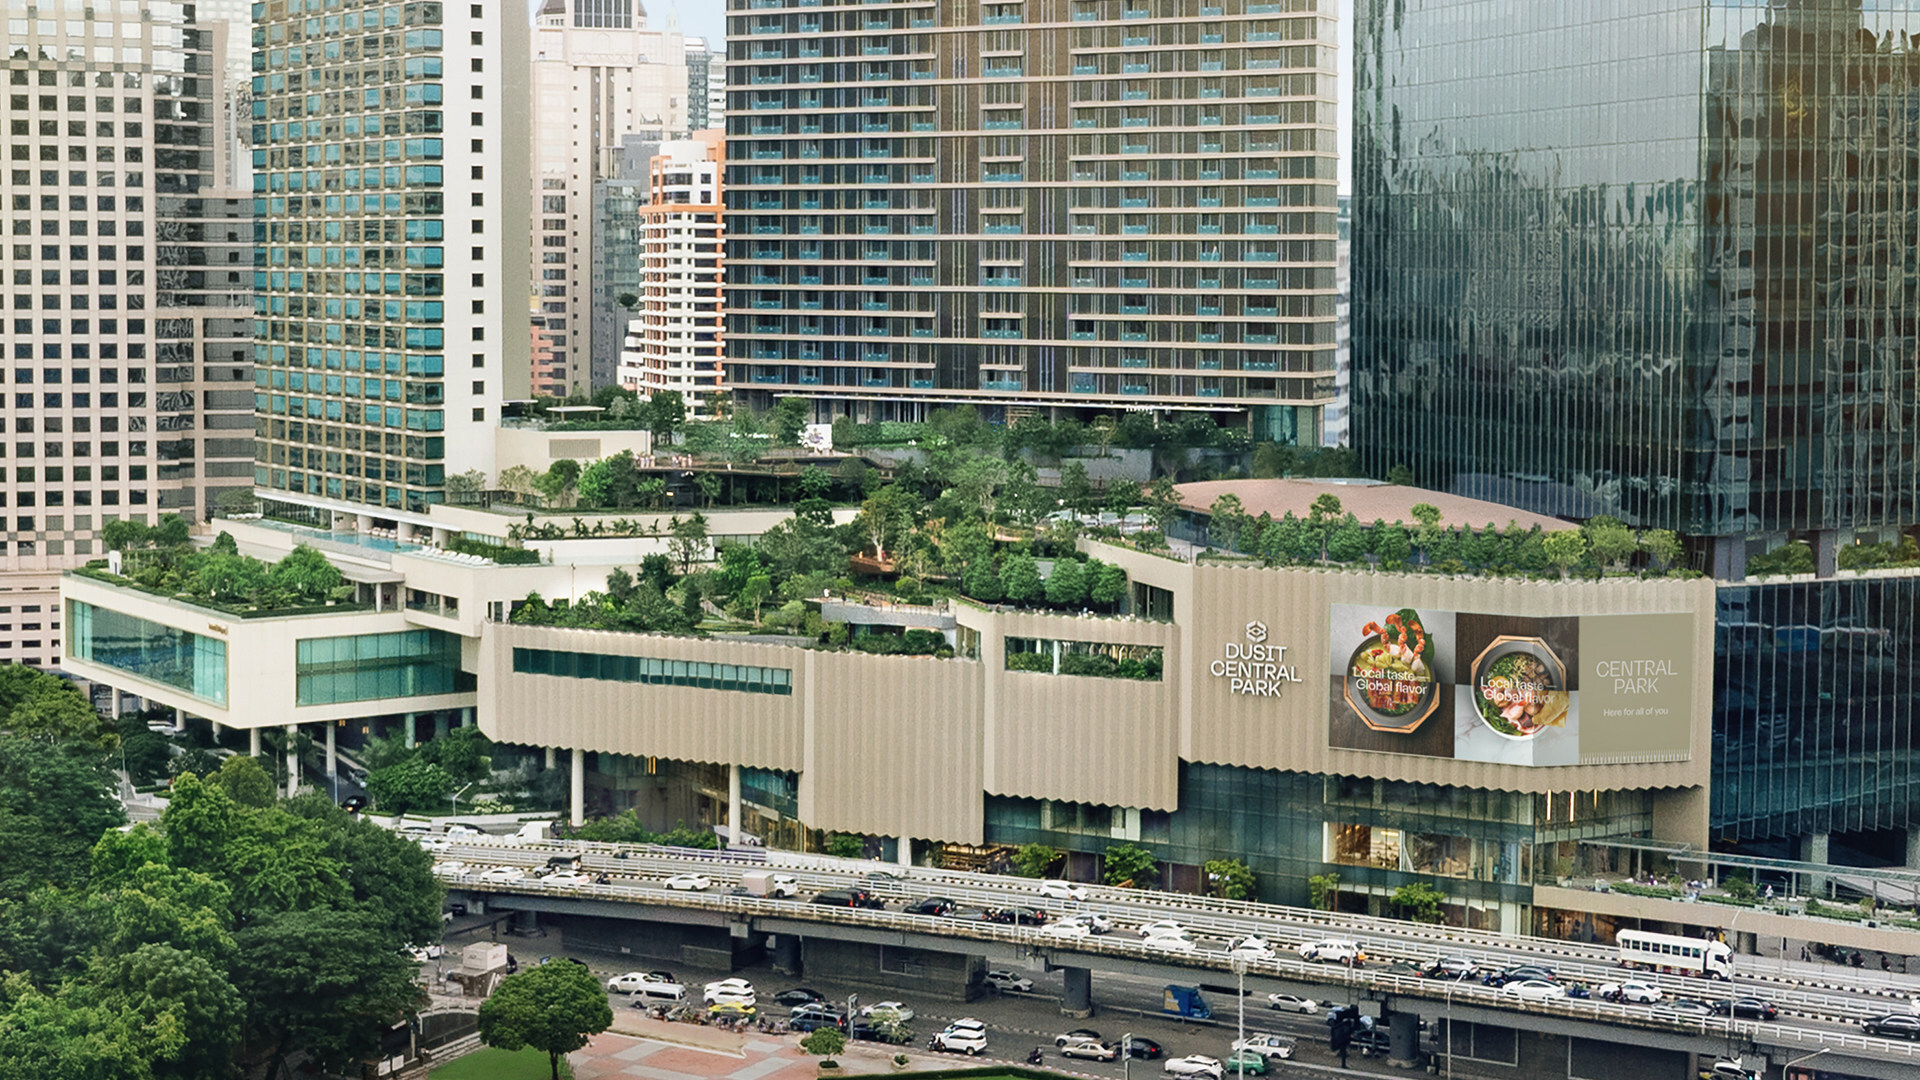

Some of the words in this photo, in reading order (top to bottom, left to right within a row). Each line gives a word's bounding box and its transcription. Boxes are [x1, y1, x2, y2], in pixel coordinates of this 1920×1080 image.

[1225, 643, 1287, 662] DUSIT
[1210, 660, 1303, 682] CENTRAL
[1352, 666, 1385, 679] Local
[1387, 669, 1416, 681] taste
[1596, 659, 1678, 678] CENTRAL
[1231, 678, 1281, 697] PARK
[1355, 678, 1393, 692] Global
[1395, 681, 1428, 695] flavor
[1480, 675, 1513, 689] Local
[1515, 677, 1544, 691] taste
[1614, 677, 1659, 694] PARK
[1483, 688, 1522, 703] Global
[1524, 690, 1555, 704] flavor
[1603, 708, 1622, 717] Here
[1623, 707, 1634, 716] for
[1635, 707, 1645, 716] all
[1645, 706, 1653, 716] of
[1654, 708, 1669, 717] you
